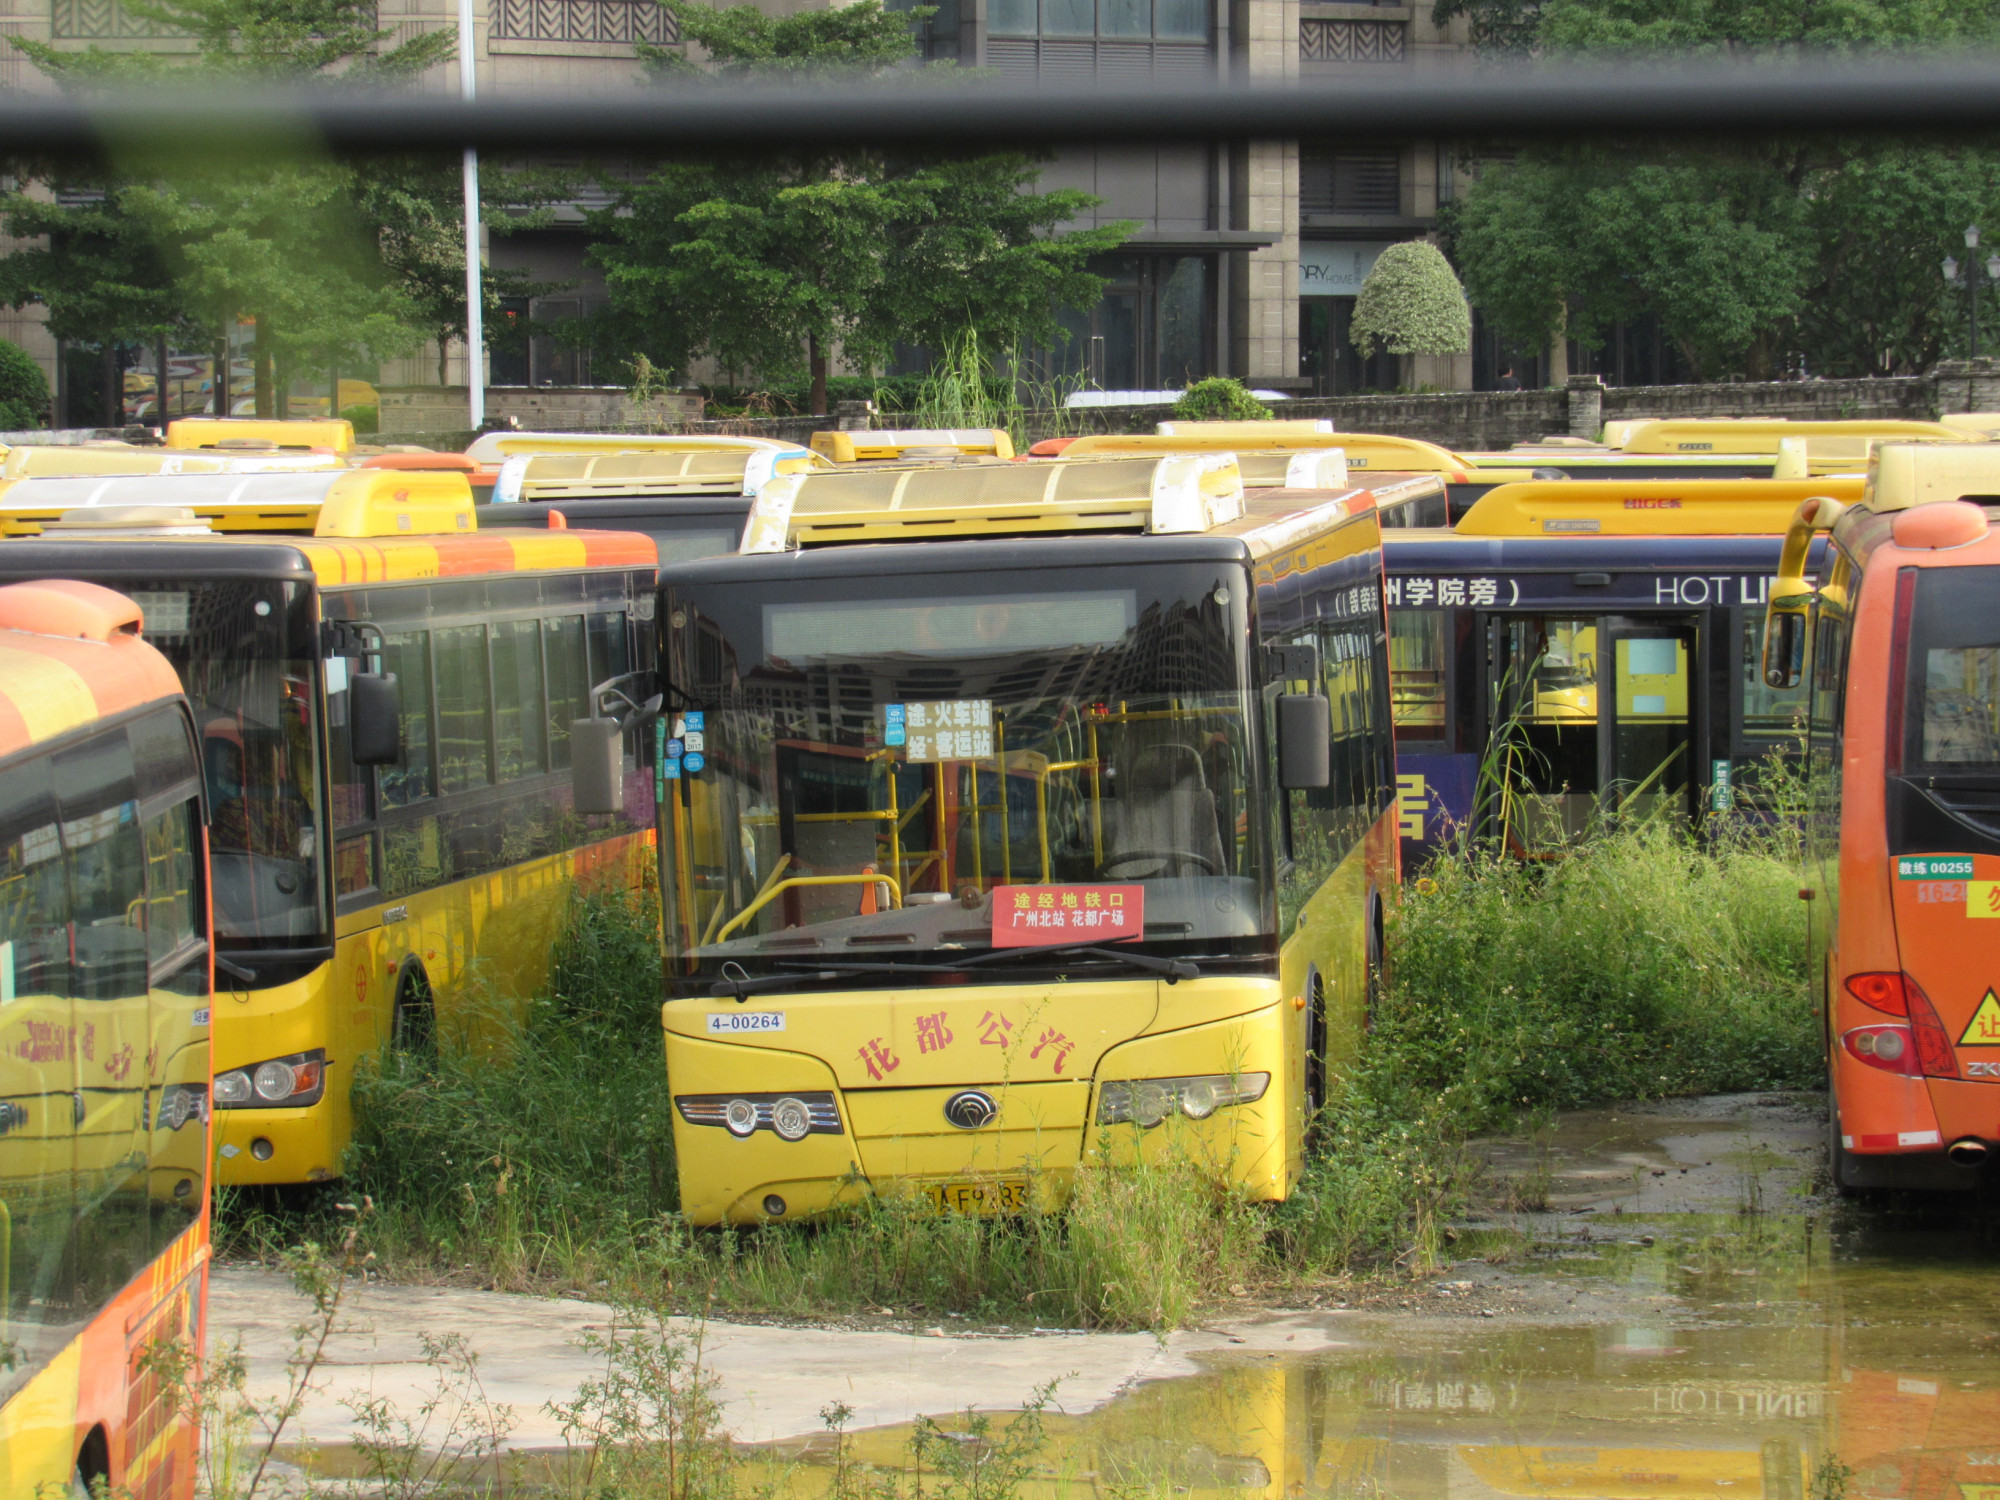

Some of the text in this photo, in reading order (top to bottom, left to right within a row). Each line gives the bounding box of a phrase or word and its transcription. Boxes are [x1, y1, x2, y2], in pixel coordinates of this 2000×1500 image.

[1656, 576, 1818, 605] HOT LI
[687, 743, 702, 751] 2017
[935, 730, 991, 758] 客运站
[1899, 861, 1972, 875] 教练 00255
[1014, 892, 1123, 909] 途经地铁口
[1012, 910, 1124, 928] 广州北站 花都广场
[712, 1015, 781, 1029] 4-00264
[855, 1009, 1076, 1082] 花都公汽
[1967, 1062, 2000, 1077] ZK
